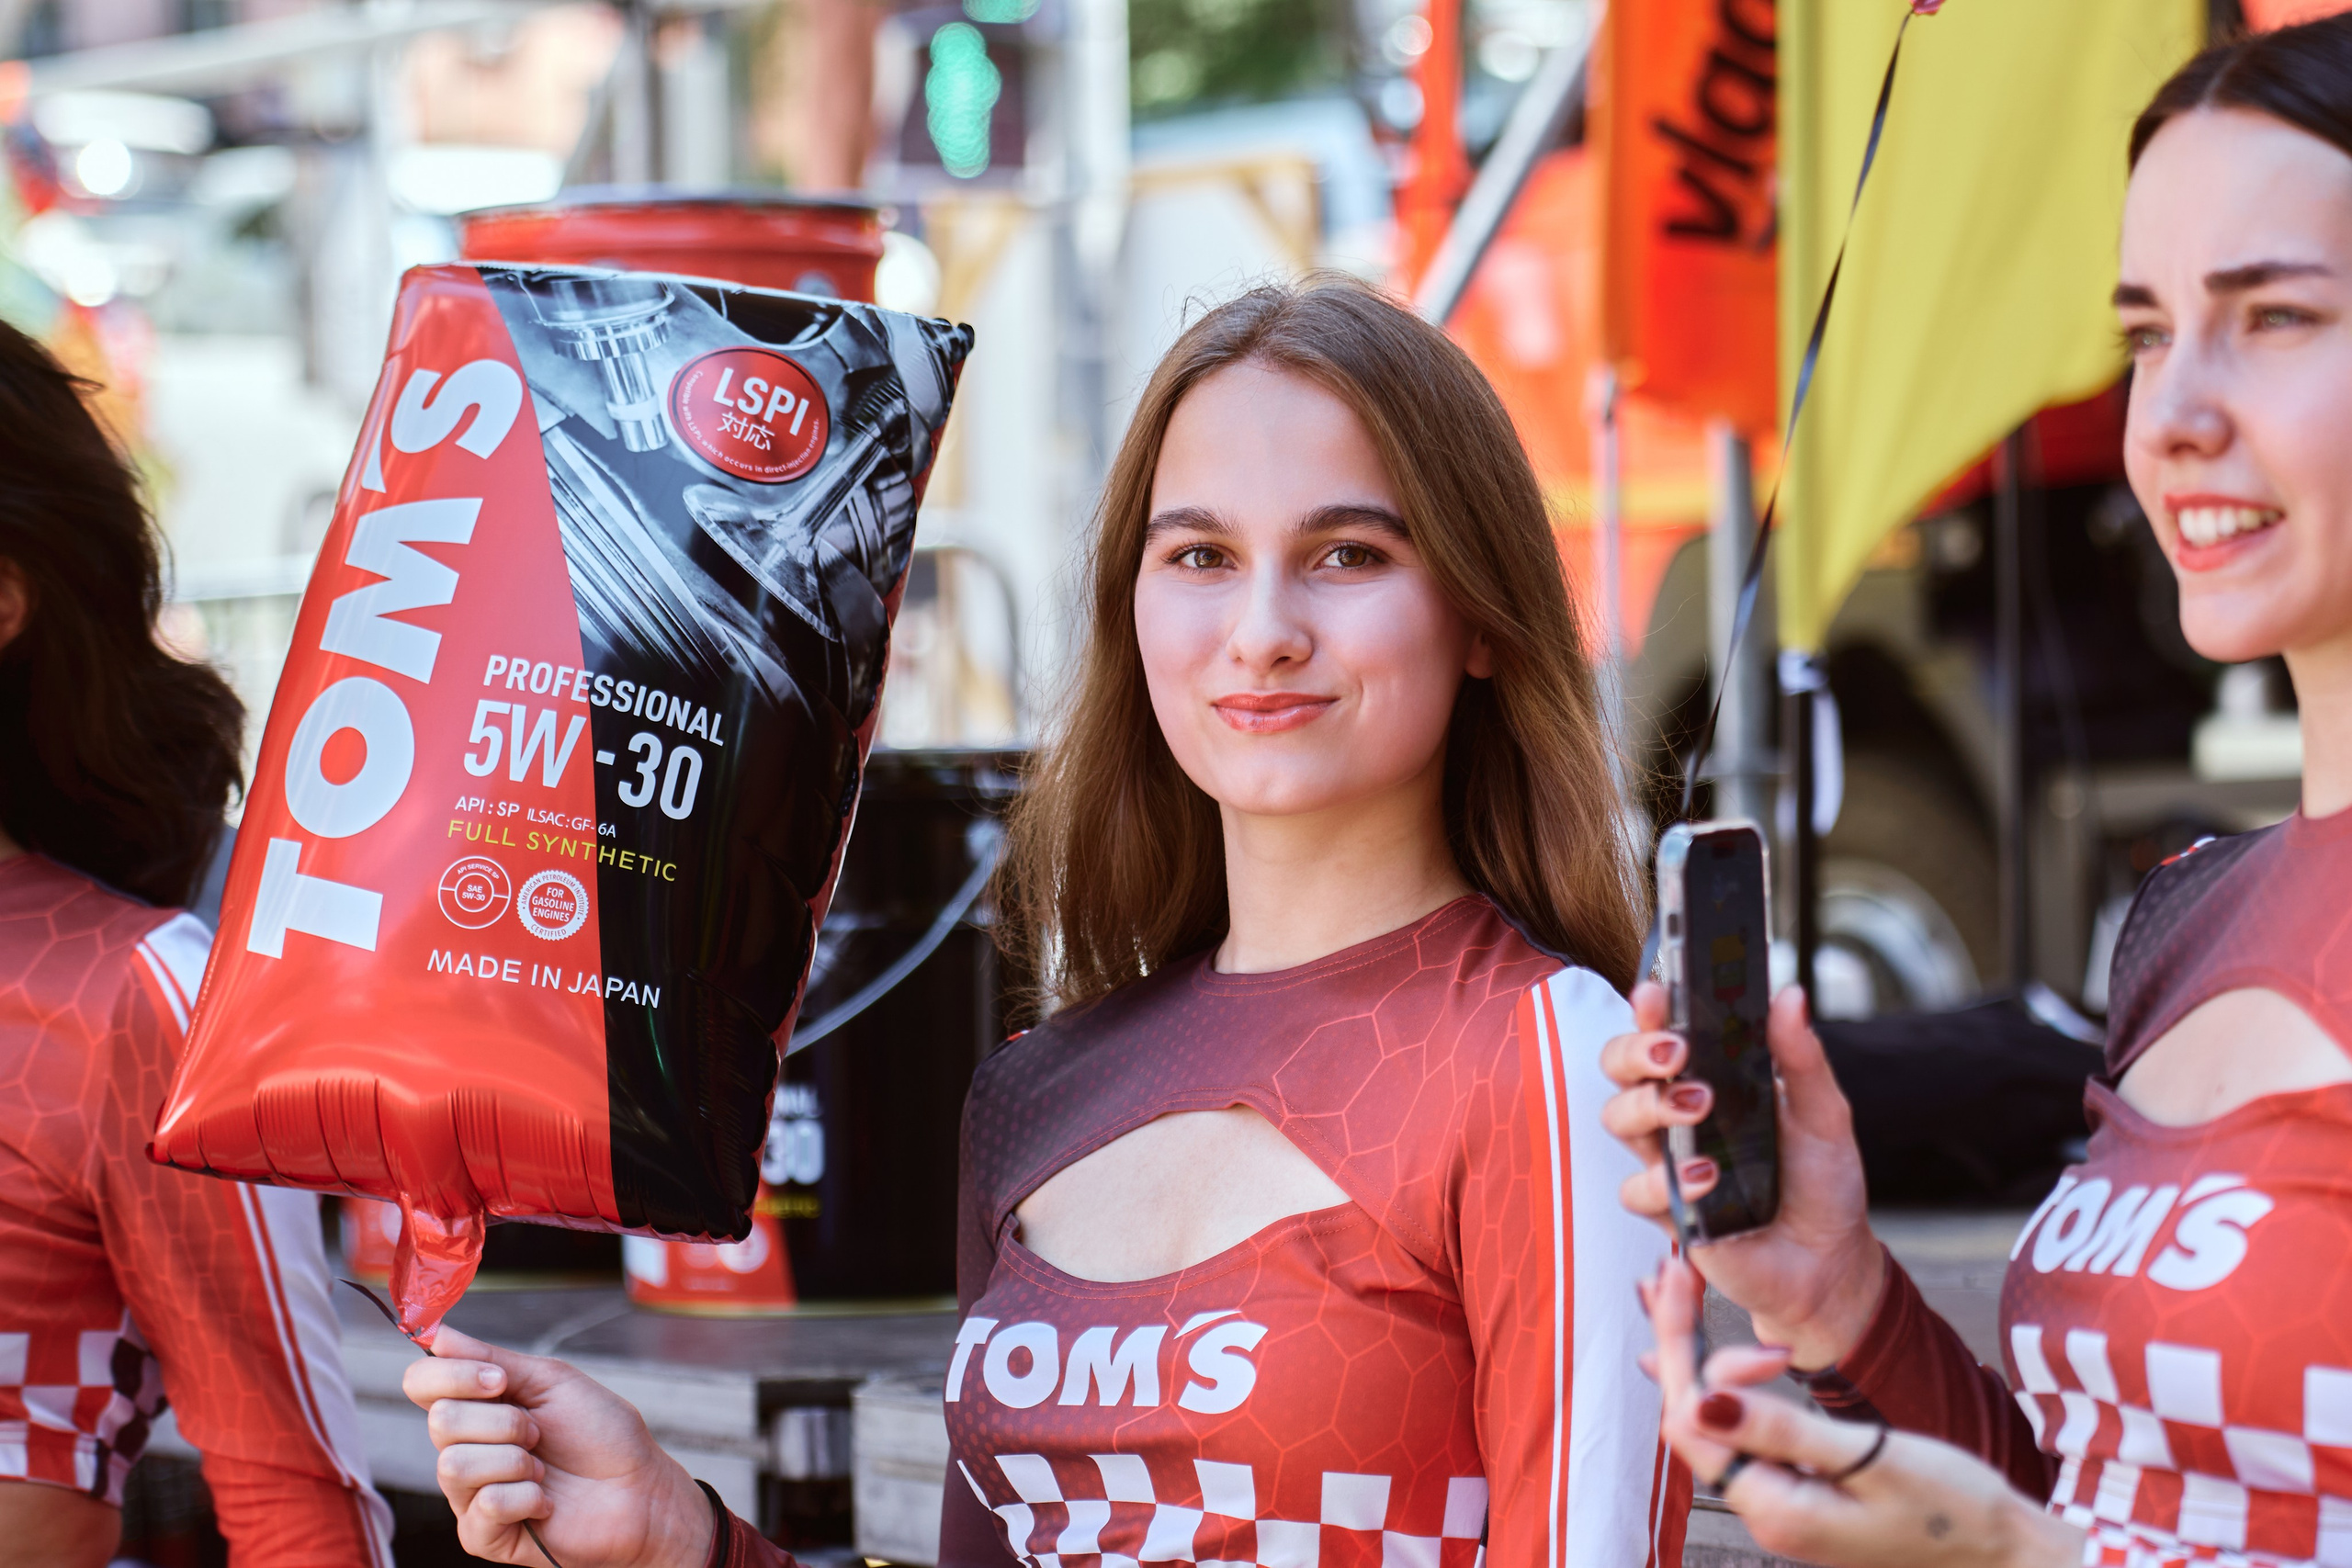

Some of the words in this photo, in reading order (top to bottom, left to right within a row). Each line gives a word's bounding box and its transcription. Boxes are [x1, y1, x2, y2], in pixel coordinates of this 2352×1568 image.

[713, 367, 809, 436] LSPI
[717, 412, 775, 451] 対応
[701, 440, 724, 458] which
[724, 456, 752, 471] occurs
[754, 466, 763, 474] in
[764, 447, 811, 474] direct-injection
[246, 359, 523, 958] TOM'S
[482, 655, 725, 747] PROFESSIONAL
[447, 819, 516, 847] FULL
[526, 831, 678, 882] SYNTHETIC
[457, 865, 468, 875] API
[467, 863, 492, 874] SERVICE
[491, 870, 500, 880] SP
[467, 885, 483, 894] SAE
[461, 892, 486, 902] 5W-30
[521, 878, 542, 905] AMERICAN
[542, 874, 576, 887] PETROLEUM
[574, 886, 585, 916] INSTITUTE
[532, 896, 575, 912] GASOLINE
[546, 886, 564, 899] FOR
[530, 923, 567, 938] CERTIFIED
[532, 907, 570, 923] ENGINES
[426, 949, 522, 983] MADE
[530, 964, 562, 990] IN
[567, 972, 661, 1009] JAPAN
[2009, 1171, 2275, 1292] TOM'S
[944, 1309, 1269, 1415] TOM'S
